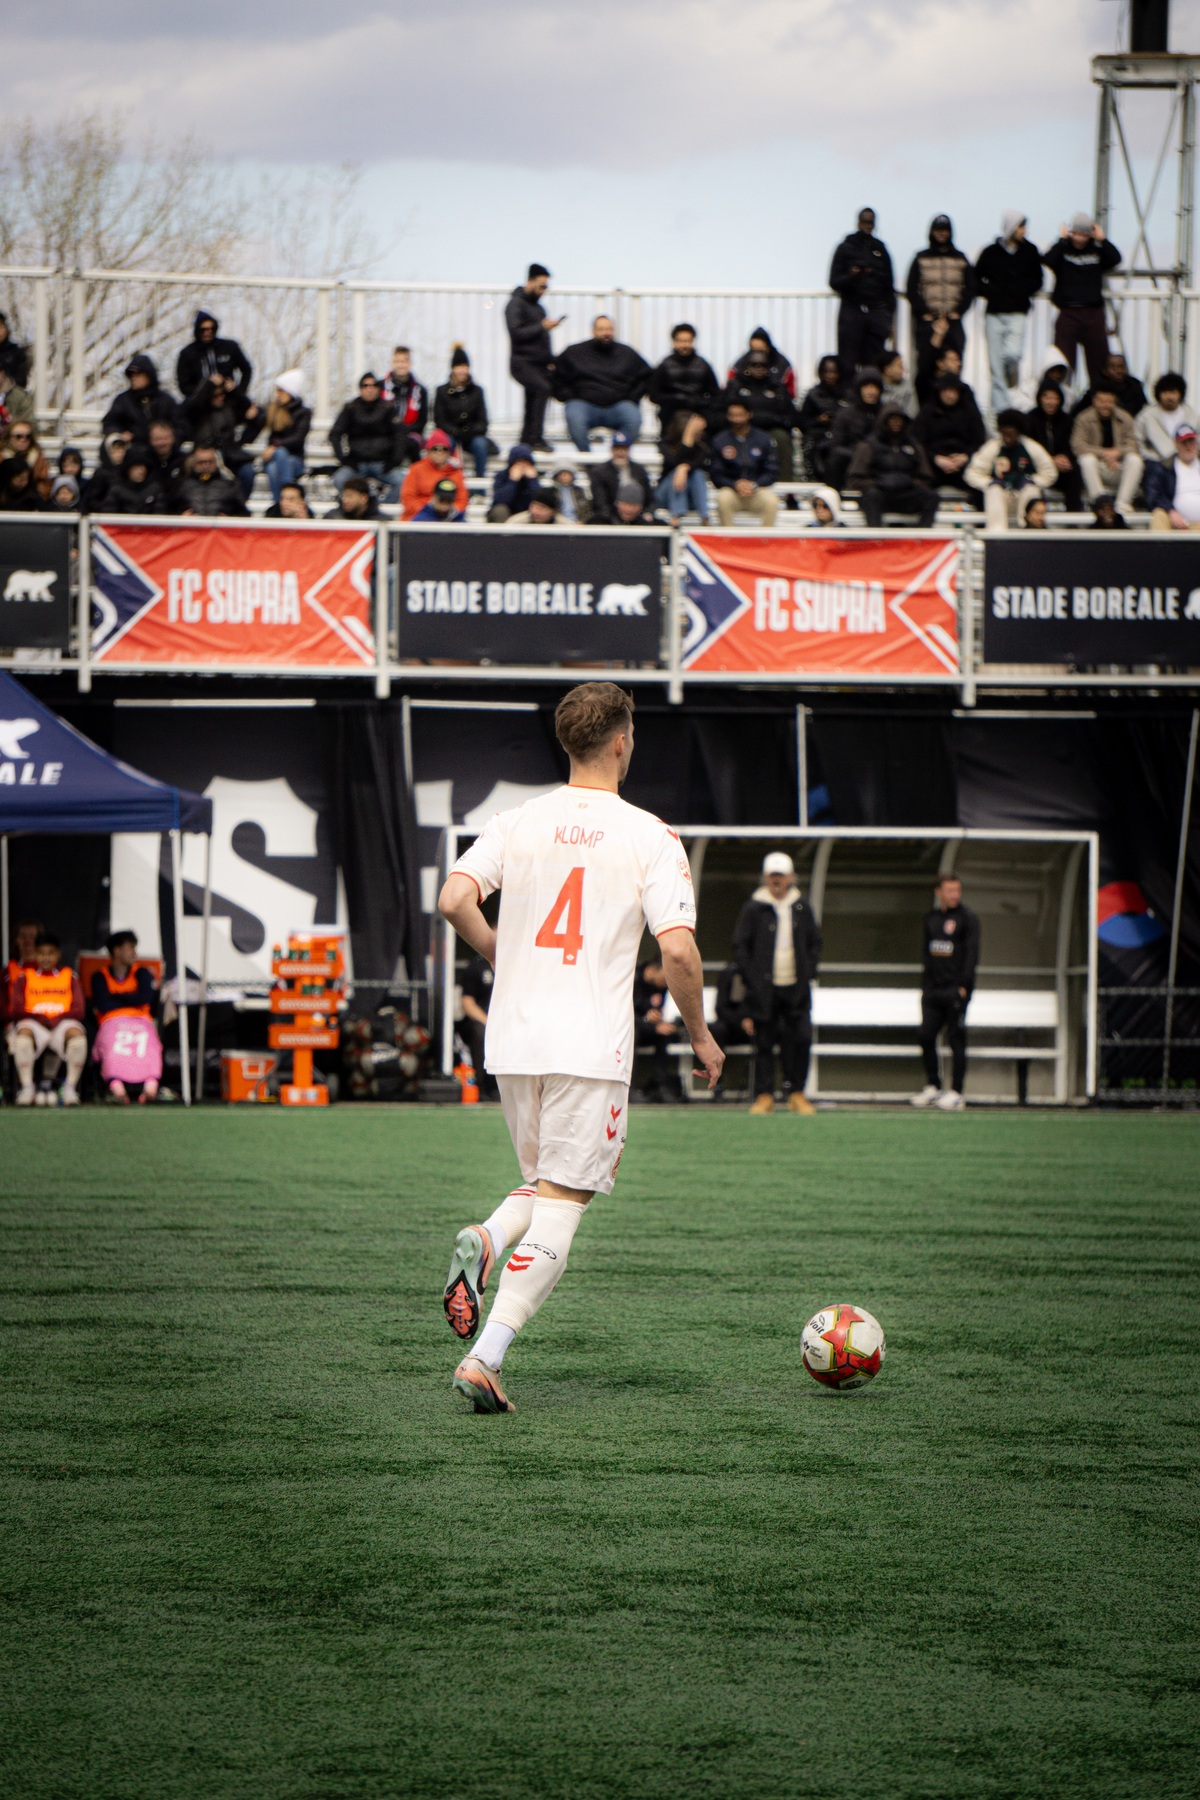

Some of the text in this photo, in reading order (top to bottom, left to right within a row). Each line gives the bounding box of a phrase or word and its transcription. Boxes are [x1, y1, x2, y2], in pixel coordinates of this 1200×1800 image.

[168, 568, 301, 625] FC SUPRA
[407, 580, 594, 615] STADE BORÉALE
[754, 577, 887, 634] FC SUPRA
[992, 585, 1180, 620] STADE BORÉALE
[554, 825, 605, 848] KLOMP
[535, 866, 585, 966] 4
[113, 1031, 149, 1058] 21
[810, 1319, 825, 1334] Voit
